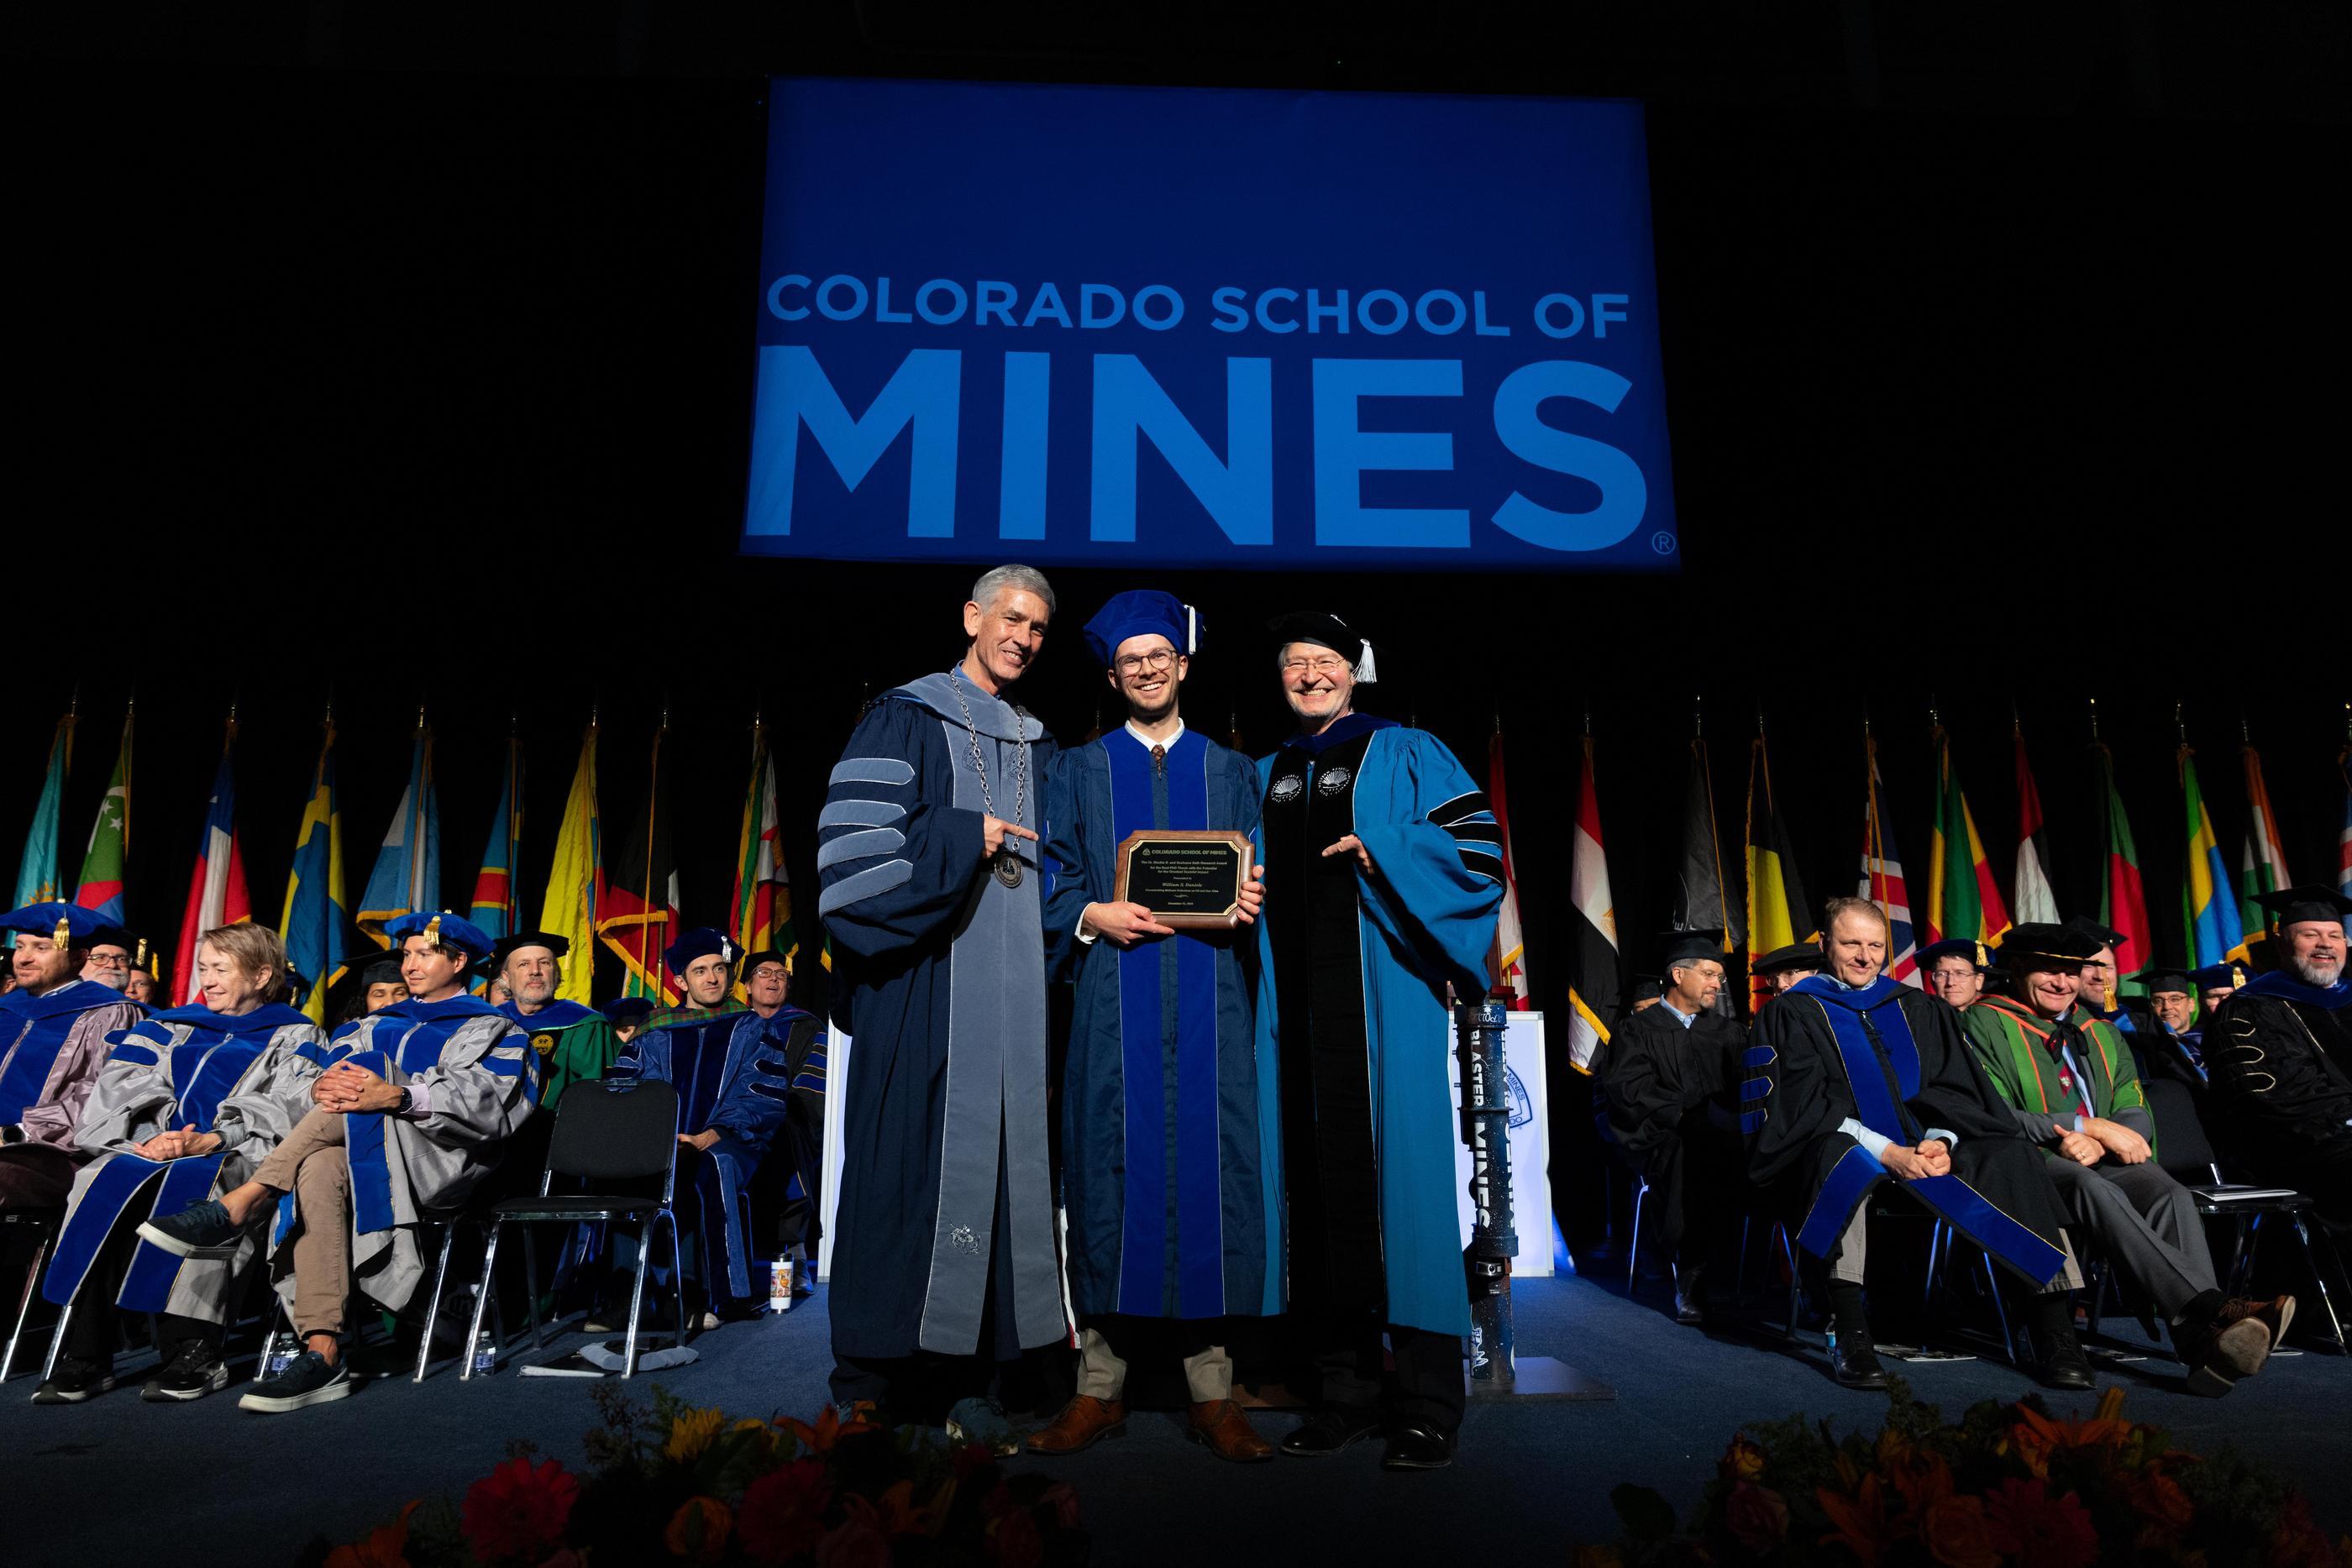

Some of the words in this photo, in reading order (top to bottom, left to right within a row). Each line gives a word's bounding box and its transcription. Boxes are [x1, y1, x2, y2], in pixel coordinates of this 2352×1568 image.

[767, 275, 1184, 330] COLORADO
[1211, 287, 1509, 336] SCHOOL
[1535, 294, 1628, 338] OF
[746, 346, 1646, 551] MINES
[1470, 1029, 1484, 1107] BLASTER
[1507, 1073, 1525, 1101] MINES
[1473, 1122, 1491, 1229] MINES
